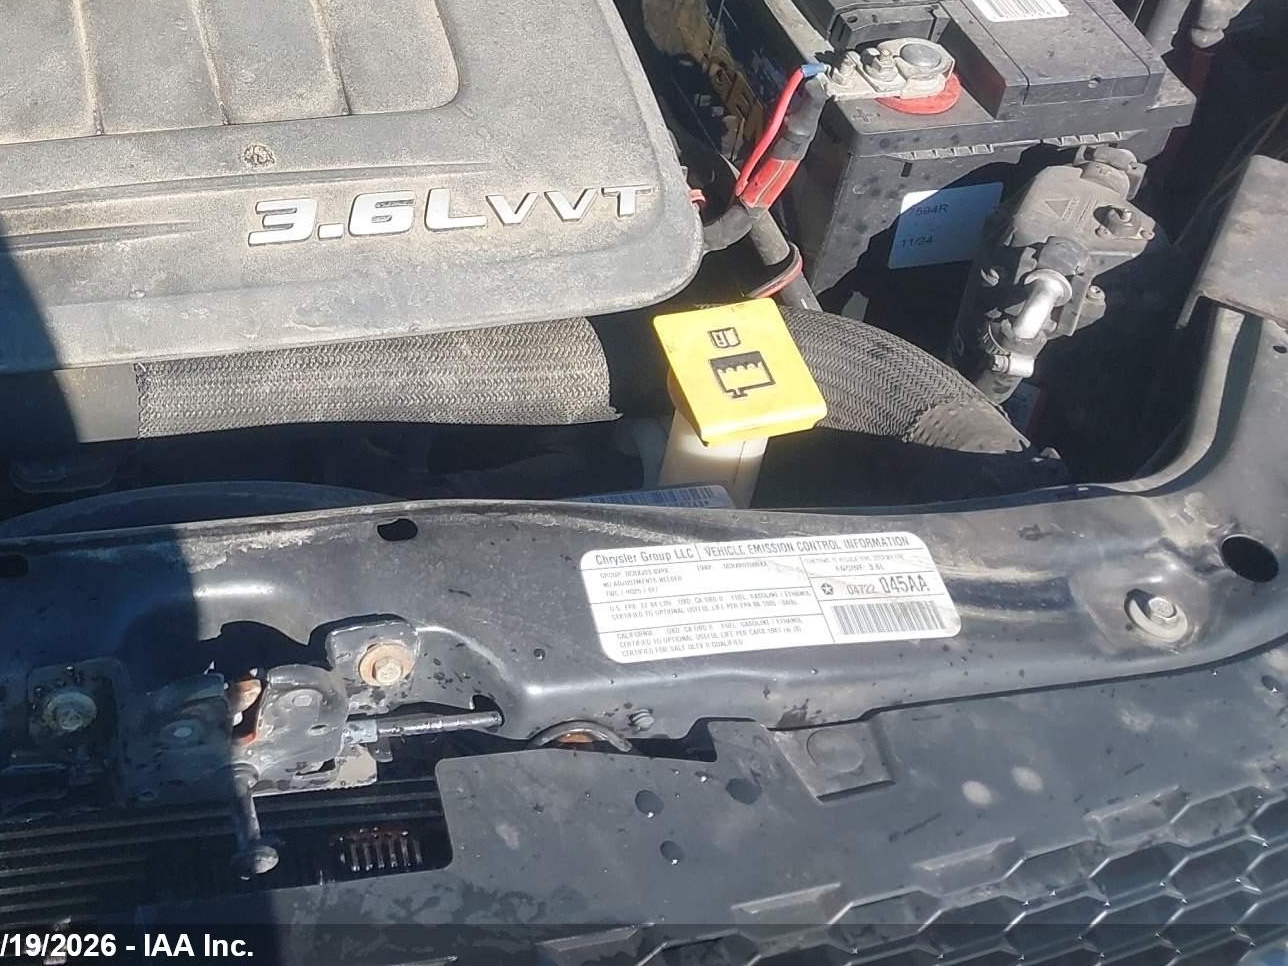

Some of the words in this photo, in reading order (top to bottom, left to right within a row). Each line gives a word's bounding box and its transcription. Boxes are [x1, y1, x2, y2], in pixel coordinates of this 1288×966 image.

[595, 550, 639, 567] Chrysler
[640, 548, 672, 565] Group
[674, 546, 695, 561] LLC
[704, 542, 744, 558] VEHICLE
[747, 539, 795, 555] EMISSION
[797, 537, 842, 552] CONTROL
[844, 534, 910, 550] INFORMATION
[880, 573, 929, 595] 045AA
